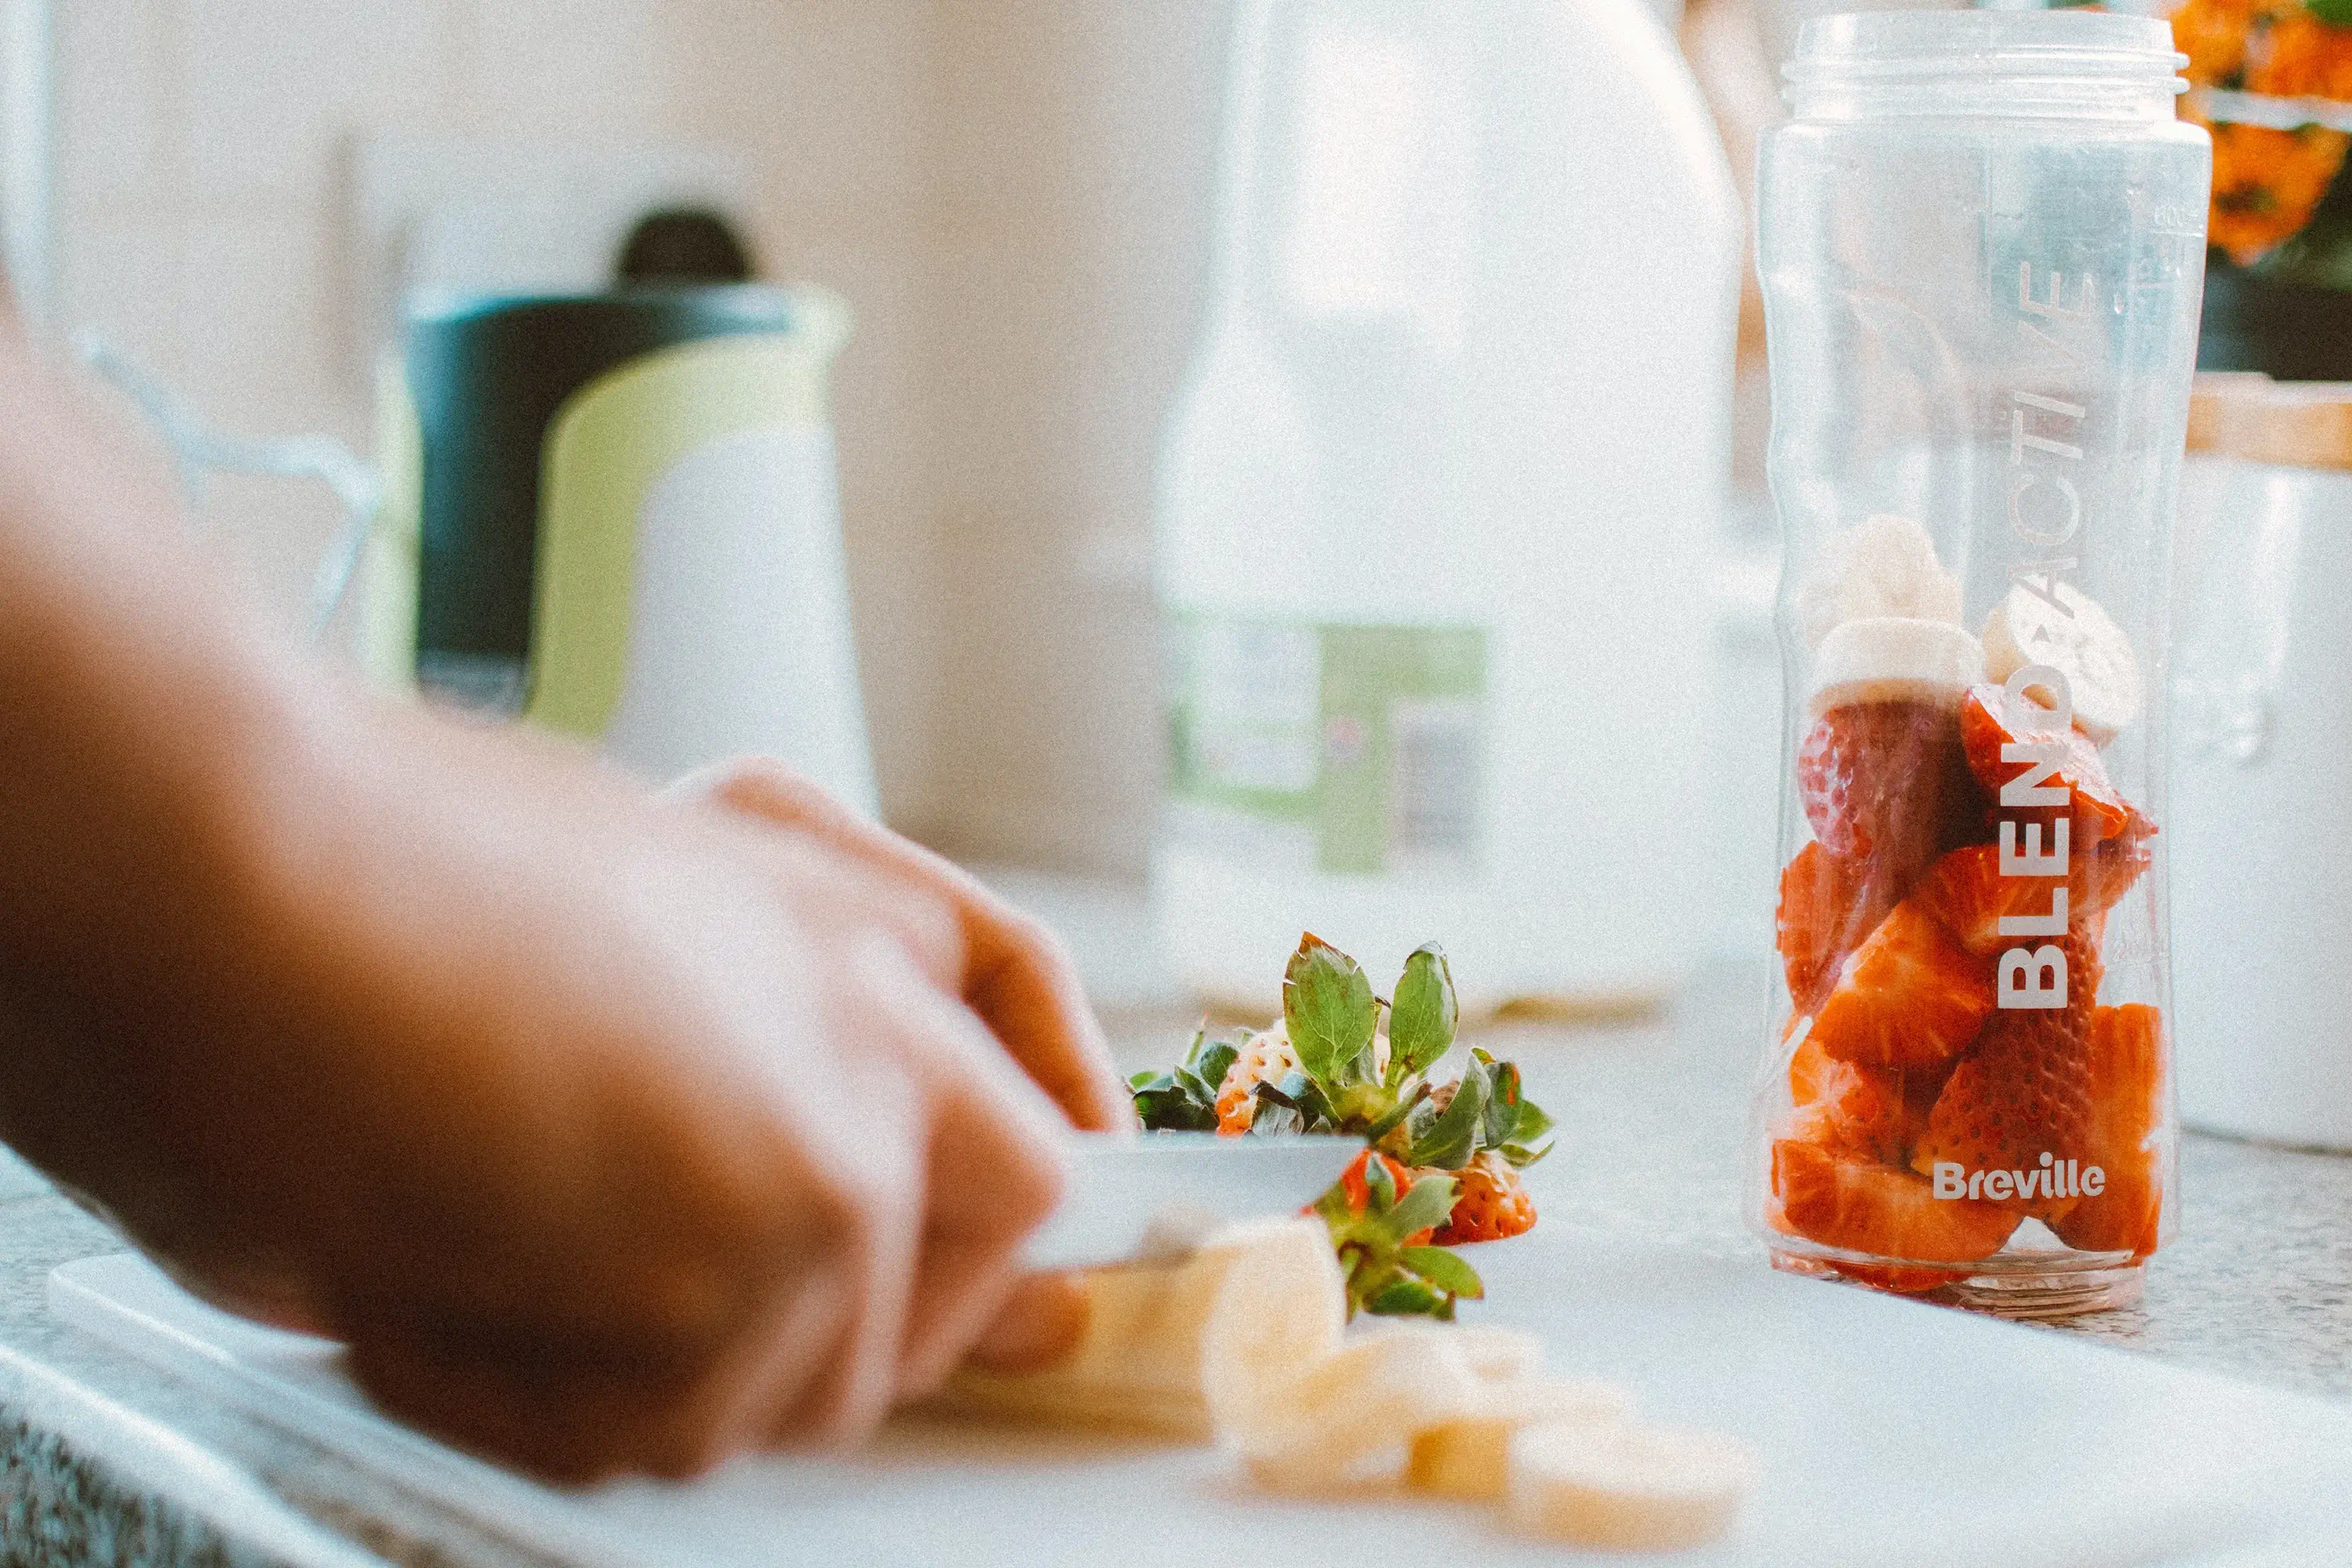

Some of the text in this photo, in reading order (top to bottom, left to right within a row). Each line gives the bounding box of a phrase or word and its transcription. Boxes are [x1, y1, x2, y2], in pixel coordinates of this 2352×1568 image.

[1998, 260, 2097, 1011] BLEND ACTIVE
[1933, 1152, 2107, 1200] Breville
